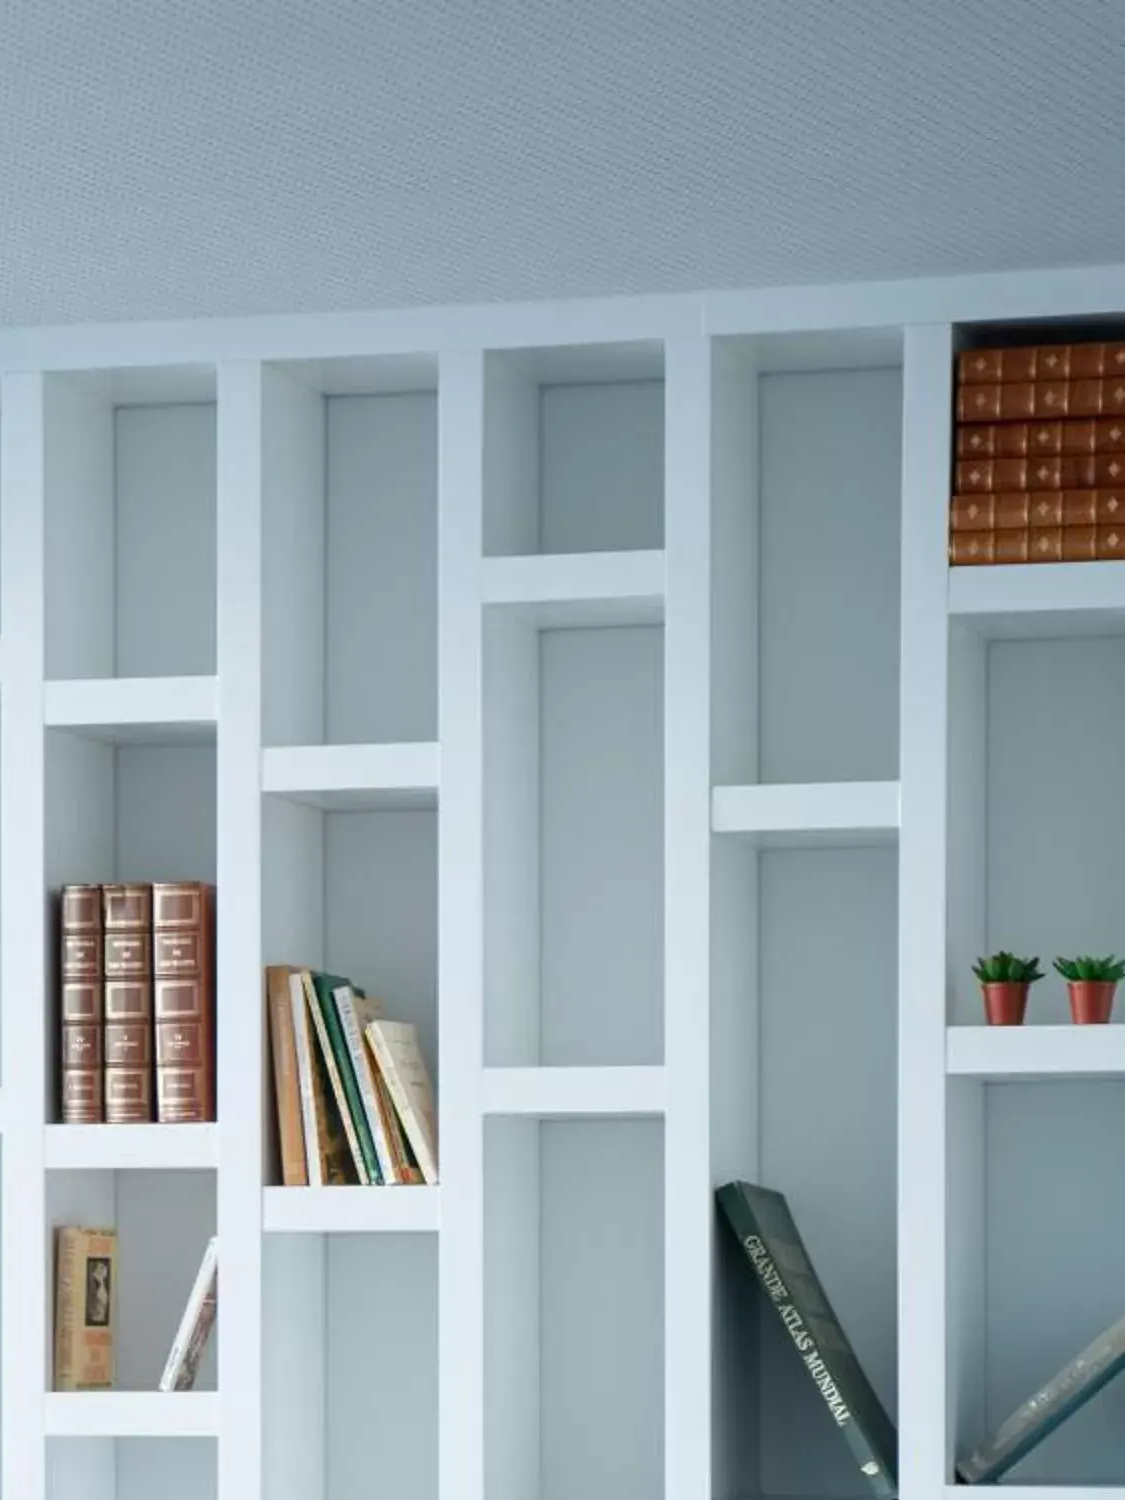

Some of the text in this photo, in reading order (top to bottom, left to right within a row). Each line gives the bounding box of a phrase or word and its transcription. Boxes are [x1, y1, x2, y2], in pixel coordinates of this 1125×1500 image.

[745, 1235, 852, 1427] GRANDE ATLAS MUNDIAL
